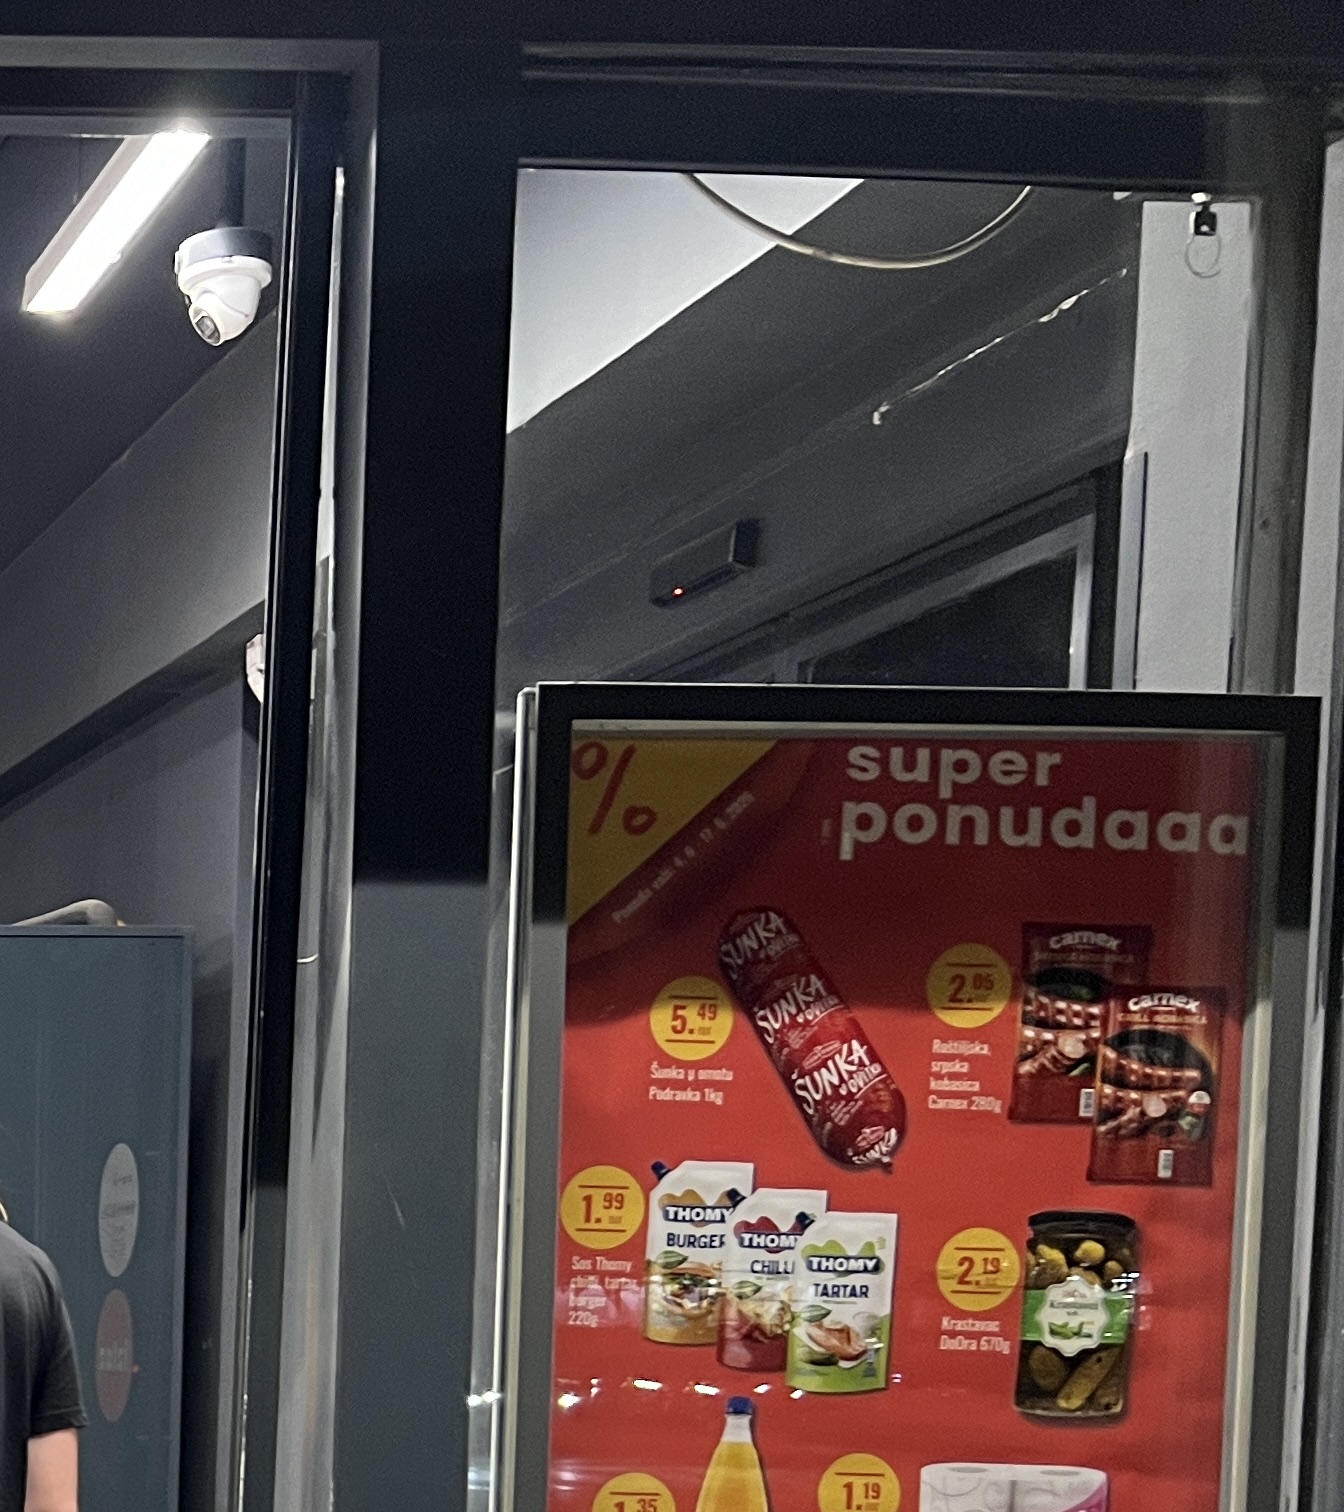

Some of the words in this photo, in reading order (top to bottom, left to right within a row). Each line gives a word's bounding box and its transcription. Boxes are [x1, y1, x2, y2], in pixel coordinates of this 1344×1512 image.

[845, 743, 1062, 800] super
[839, 796, 1251, 862] ponudaaa
[1128, 992, 1201, 1014] carnex
[671, 1002, 718, 1036] 5.49
[791, 1039, 868, 1115] ŠUNKA
[581, 1192, 624, 1224] 1.99
[666, 1206, 733, 1223] THOMY
[740, 1233, 797, 1249] THOM
[809, 1257, 878, 1273] THOMY
[956, 1256, 1001, 1286] 2.19
[813, 1284, 869, 1299] TARTAR
[843, 1481, 881, 1511] 1.19
